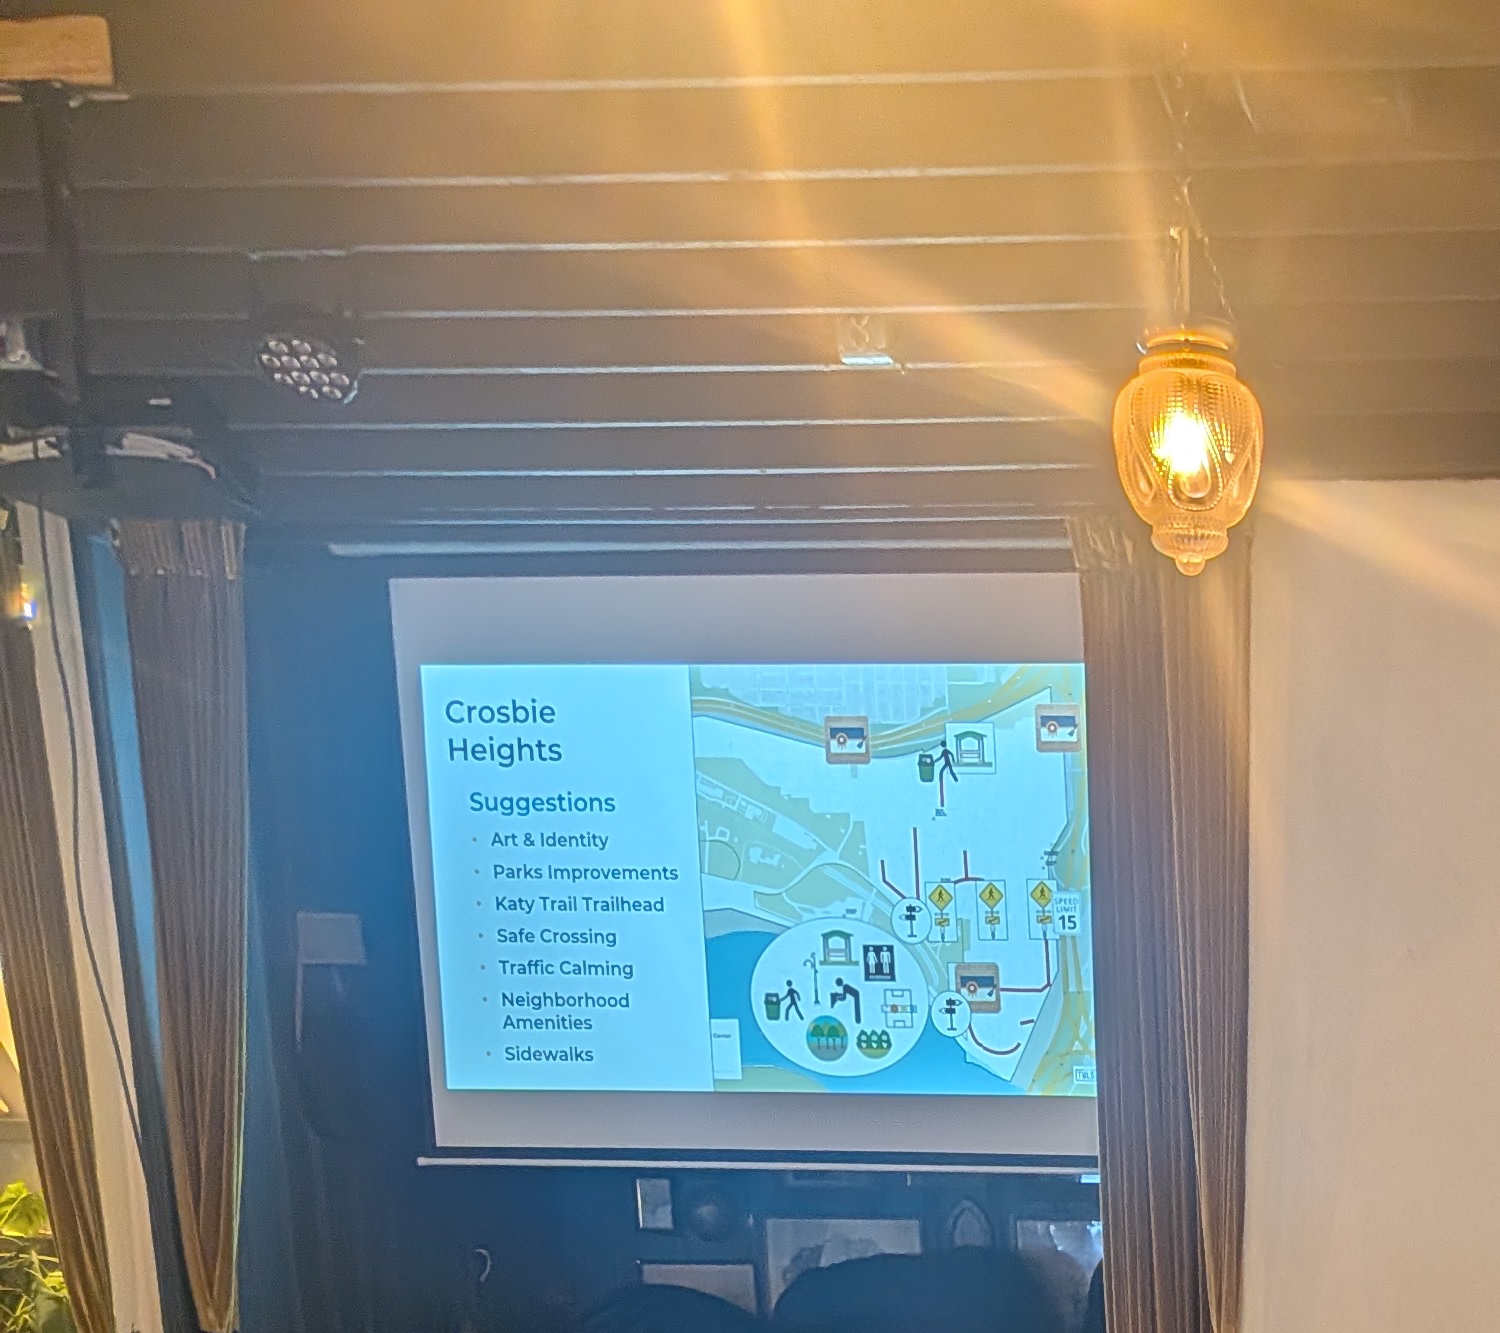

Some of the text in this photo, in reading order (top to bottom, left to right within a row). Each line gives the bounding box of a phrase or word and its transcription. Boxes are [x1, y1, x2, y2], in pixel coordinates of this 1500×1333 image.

[446, 698, 556, 724] Crosbie
[448, 736, 563, 768] Heights
[469, 791, 616, 817] Suggestions
[490, 832, 609, 850] Art & Identity
[493, 864, 679, 884] Parks Improvements
[495, 896, 665, 914] Katy Trail Trailhead
[1054, 897, 1079, 906] SPEED
[1056, 904, 1077, 913] LIMIT
[1058, 915, 1077, 930] 15
[497, 928, 617, 947] Safe Crossing
[498, 959, 634, 979] Traffic Calming
[501, 992, 630, 1010] Neighborhood
[502, 1014, 593, 1030] Amenities
[504, 1045, 594, 1062] Sidewalks
